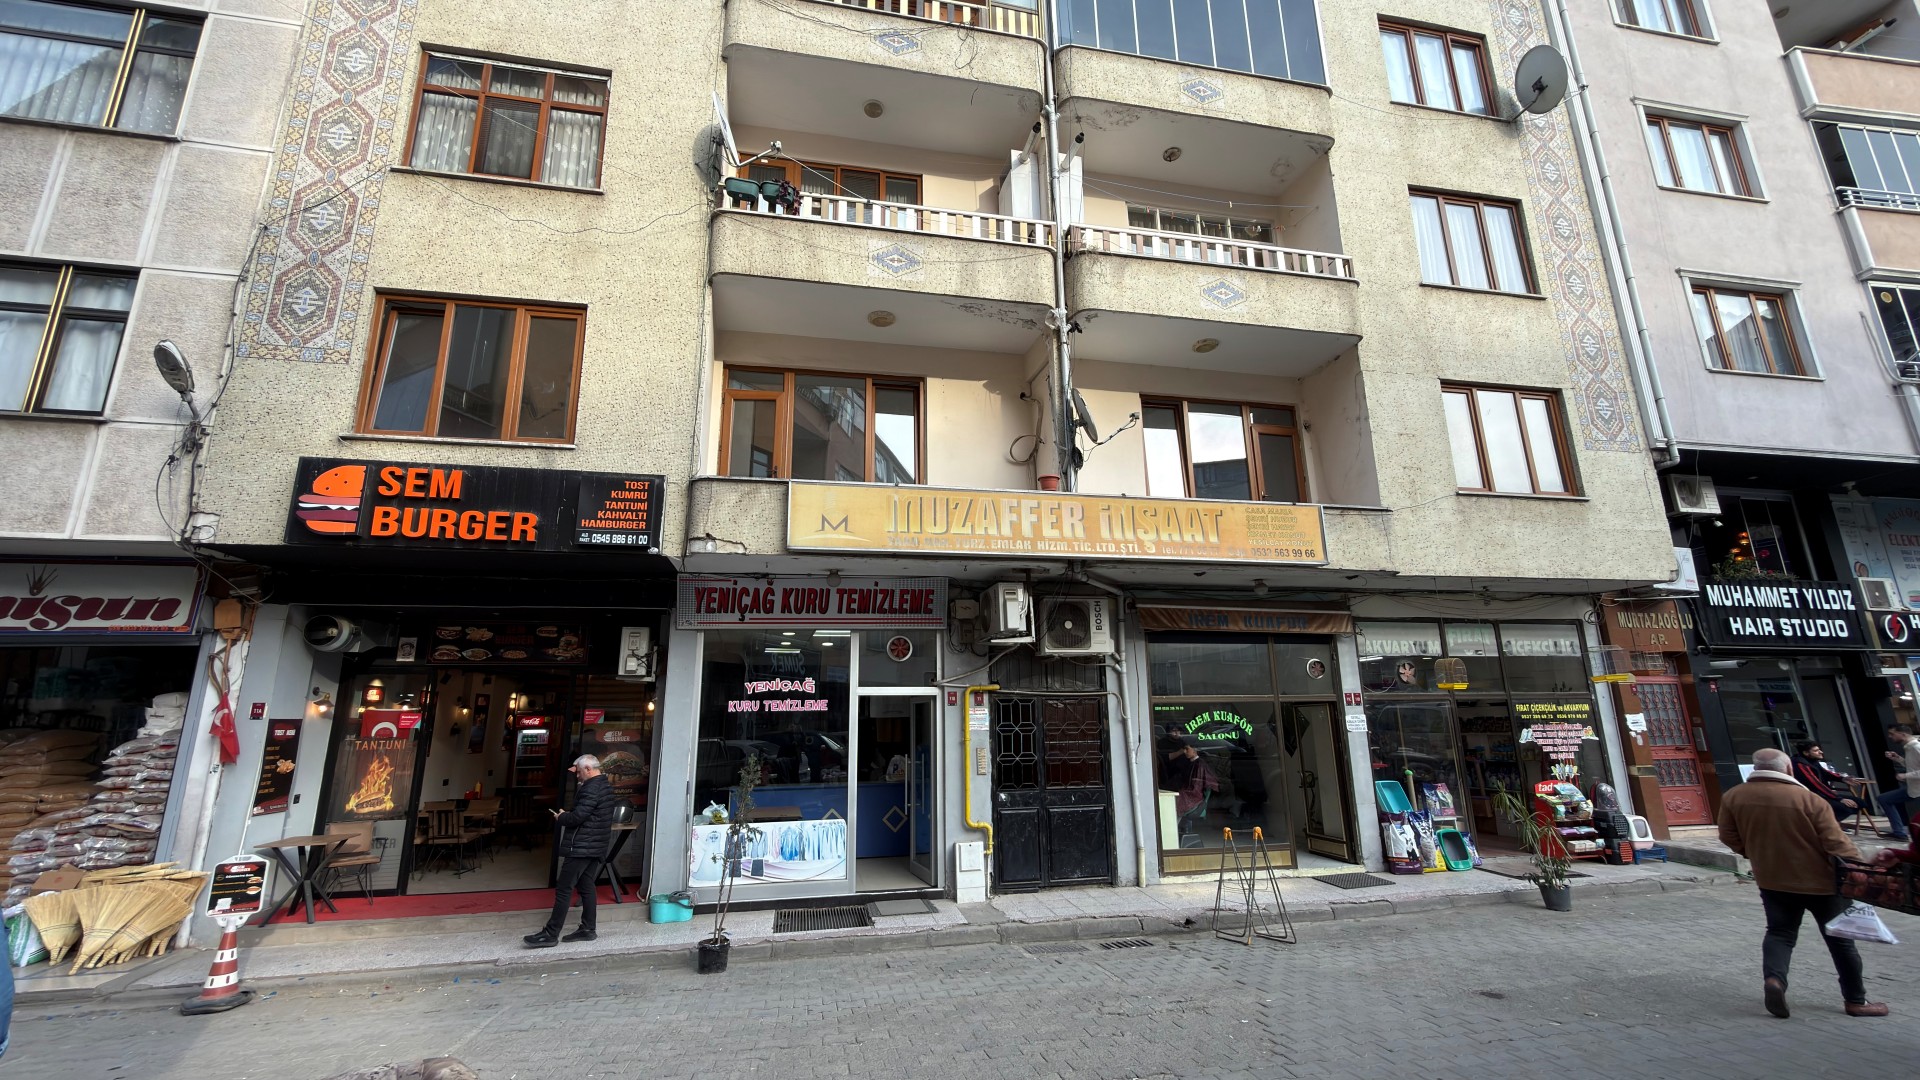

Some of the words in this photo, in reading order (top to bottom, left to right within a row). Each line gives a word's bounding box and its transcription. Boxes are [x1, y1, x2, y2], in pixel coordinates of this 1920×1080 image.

[377, 467, 463, 499] SEM
[624, 481, 650, 490] TOST
[611, 490, 648, 500] KUMRU
[604, 501, 648, 511] TANTUNİ
[597, 510, 647, 520] KAHVALTI
[370, 505, 538, 542] BURGER
[581, 519, 646, 530] HAMBURGER
[886, 496, 1084, 538] MUZAFFER
[1100, 502, 1222, 552] İNŞAAT
[592, 534, 611, 543] 0545
[627, 535, 637, 544] 61
[638, 535, 648, 545] 00
[991, 540, 1031, 550] EMLAK
[1036, 538, 1071, 551] HİZM.
[1072, 540, 1094, 552] TİC.
[1096, 542, 1118, 553] LTD.
[1120, 541, 1142, 555] ŞTİ.
[1274, 548, 1290, 558] 563
[1291, 549, 1303, 559] 99
[1304, 549, 1316, 560] 66
[694, 579, 775, 621] YENİÇAĞ
[780, 587, 831, 615] KURU
[836, 581, 935, 615] TEMİZLEME
[1706, 585, 1799, 608] MUHAMMET
[1802, 588, 1856, 610] YILDIZ
[1095, 601, 1103, 631] BOSCH
[1617, 611, 1694, 630] MURTAZAOĞLU
[1729, 617, 1776, 635] HAIR
[1779, 617, 1848, 637] STUDIO
[1650, 633, 1668, 645] AP.
[1365, 640, 1441, 654] AKVARYUM
[745, 678, 815, 694] YENİÇAĞ
[728, 699, 760, 712] KURU
[763, 699, 828, 711] TEMİZLEME
[1515, 703, 1530, 712] FIRAT
[1563, 703, 1590, 712] AKVARYUM
[1184, 713, 1211, 735] İREM
[1213, 709, 1254, 736] KUAFÖR
[1197, 731, 1240, 741] SALONU
[355, 739, 407, 751] TANTUNİ
